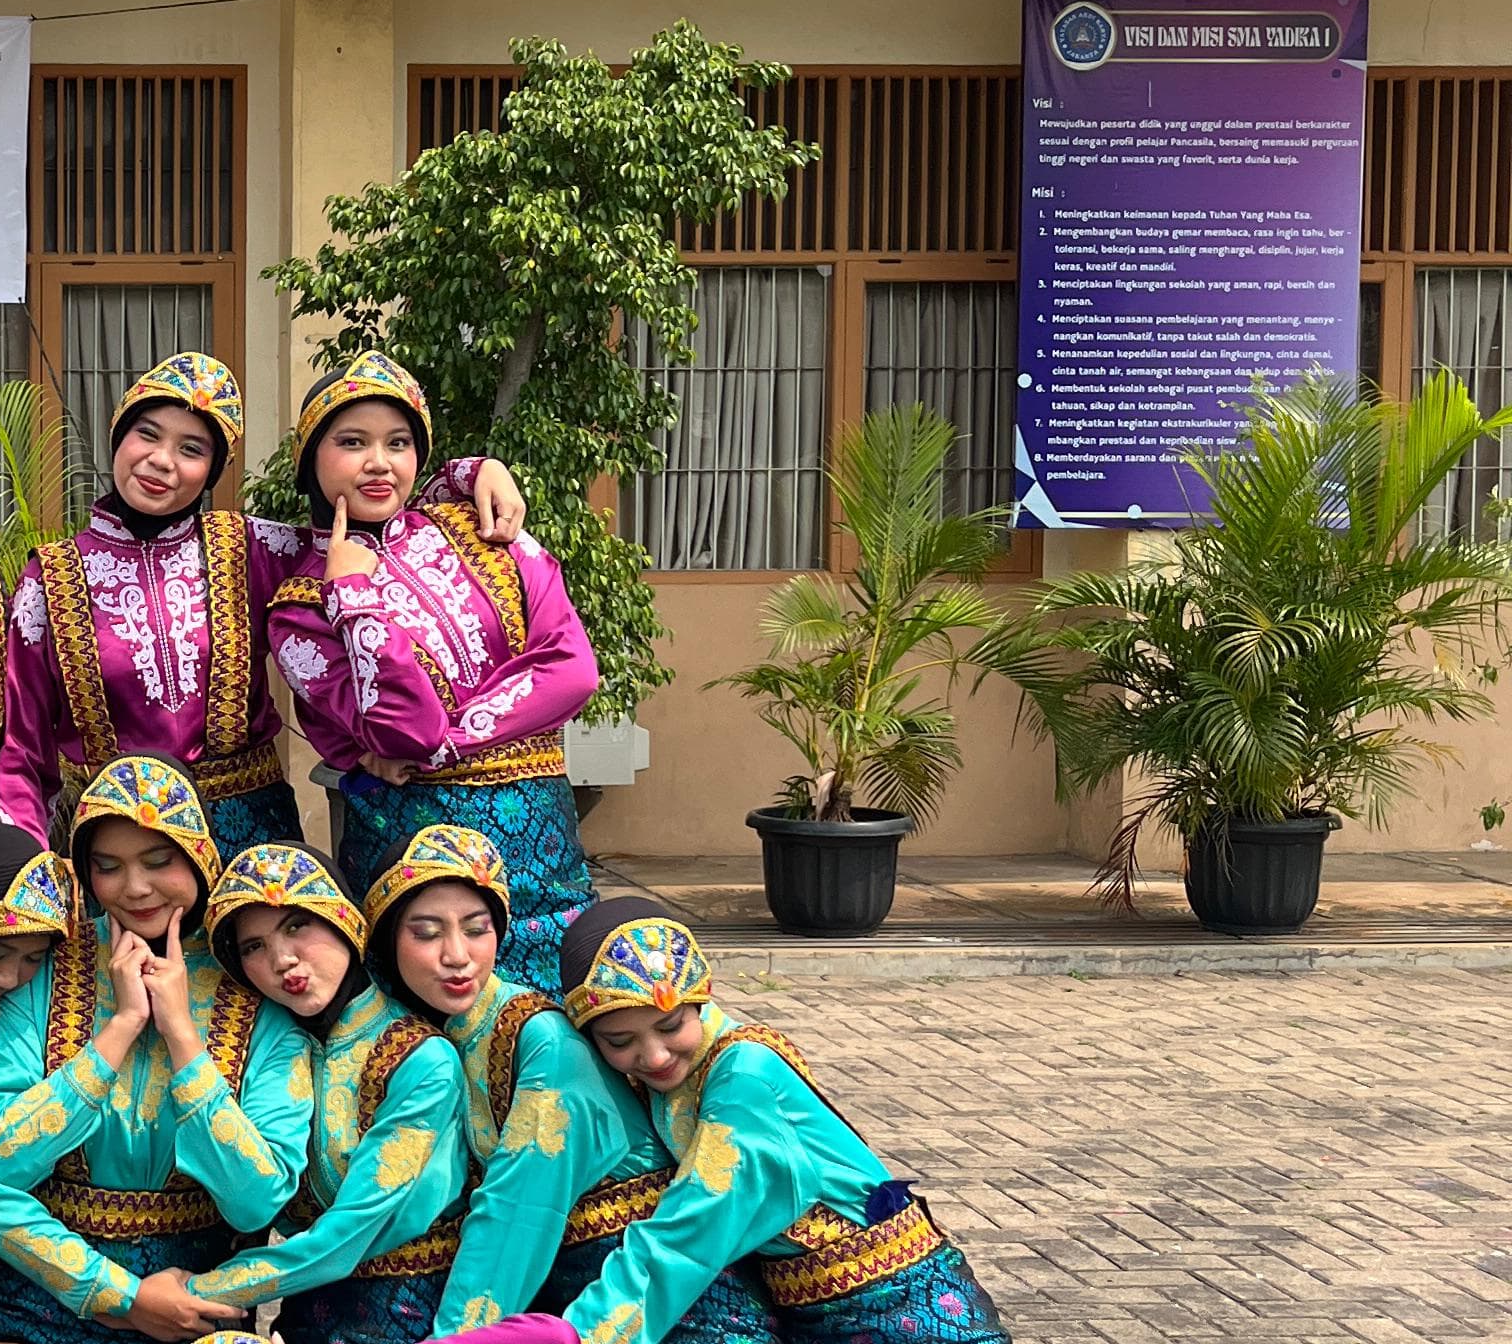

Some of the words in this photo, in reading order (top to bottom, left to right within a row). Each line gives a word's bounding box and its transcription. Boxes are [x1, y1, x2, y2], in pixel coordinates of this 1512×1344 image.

[1124, 26, 1154, 47] VISI
[1157, 26, 1189, 47] DAN
[1191, 26, 1224, 47] MISI
[1227, 26, 1262, 47] SMA
[1265, 26, 1321, 48] YADIKA
[1324, 27, 1330, 48] 1
[1032, 97, 1053, 109] Visi
[1031, 186, 1054, 198] Misi
